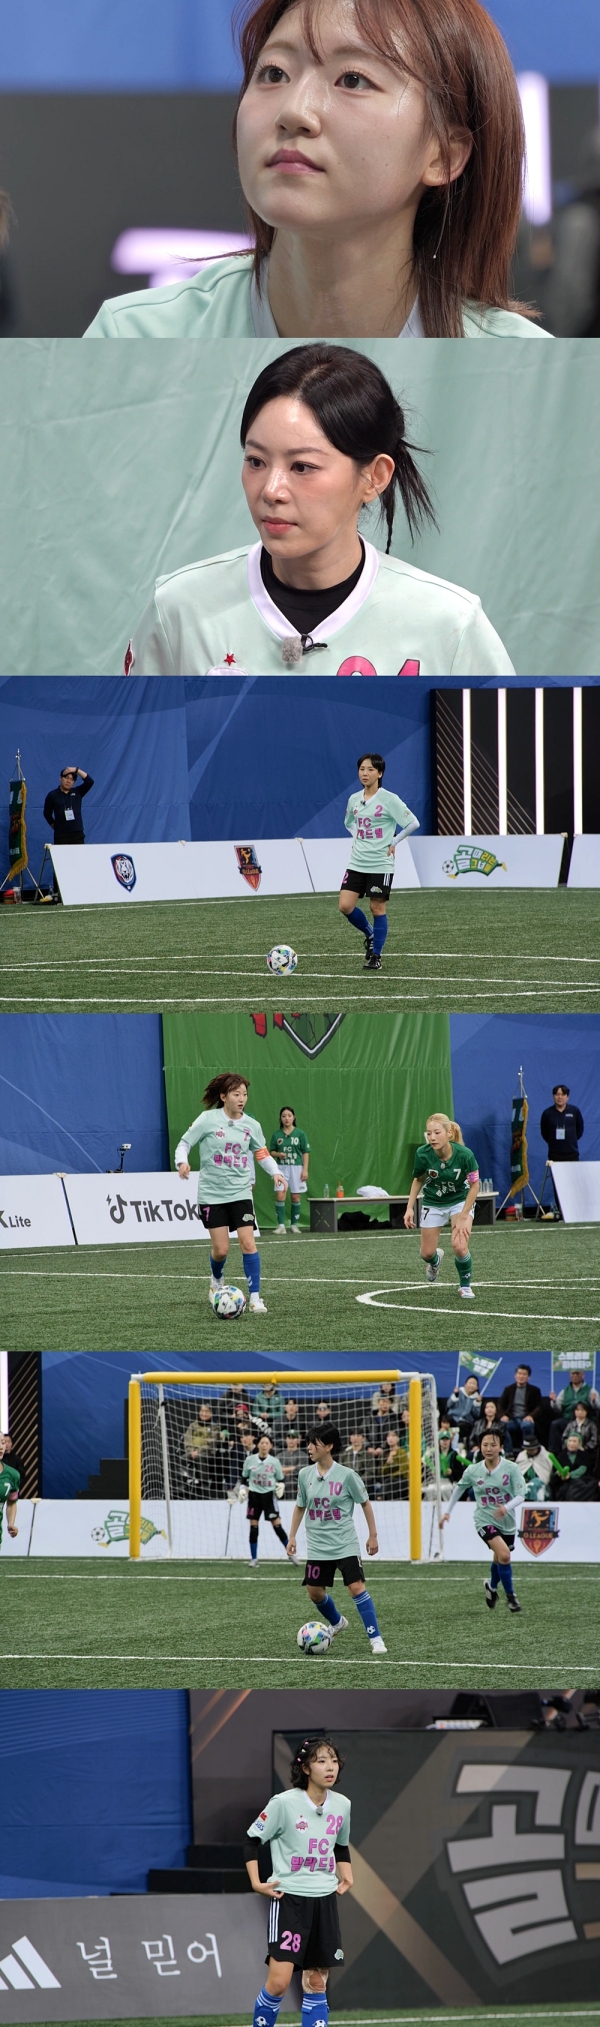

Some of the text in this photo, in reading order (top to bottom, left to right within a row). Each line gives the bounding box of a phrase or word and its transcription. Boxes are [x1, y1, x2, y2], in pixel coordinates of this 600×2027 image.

[374, 804, 383, 817] 2
[358, 817, 371, 828] FC
[342, 871, 349, 884] 2
[244, 1128, 251, 1141] 7
[291, 1137, 299, 1145] 10
[224, 1142, 242, 1154] FC
[453, 1168, 462, 1180] 7
[129, 1199, 202, 1223] TikTok
[203, 1206, 211, 1221] 7
[423, 1207, 430, 1220] 7
[8, 1215, 32, 1228] Lite
[502, 1474, 510, 1486] 2
[4, 1482, 11, 1496] 7
[328, 1481, 343, 1496] 10
[485, 1487, 500, 1495] FC
[313, 1497, 331, 1509] FC
[307, 1564, 321, 1579] 10
[325, 1814, 344, 1835] 28
[308, 1838, 330, 1855] FC
[446, 1763, 579, 1965] 골
[279, 1930, 302, 1953] 28
[76, 1933, 222, 1980] 널 믿어
